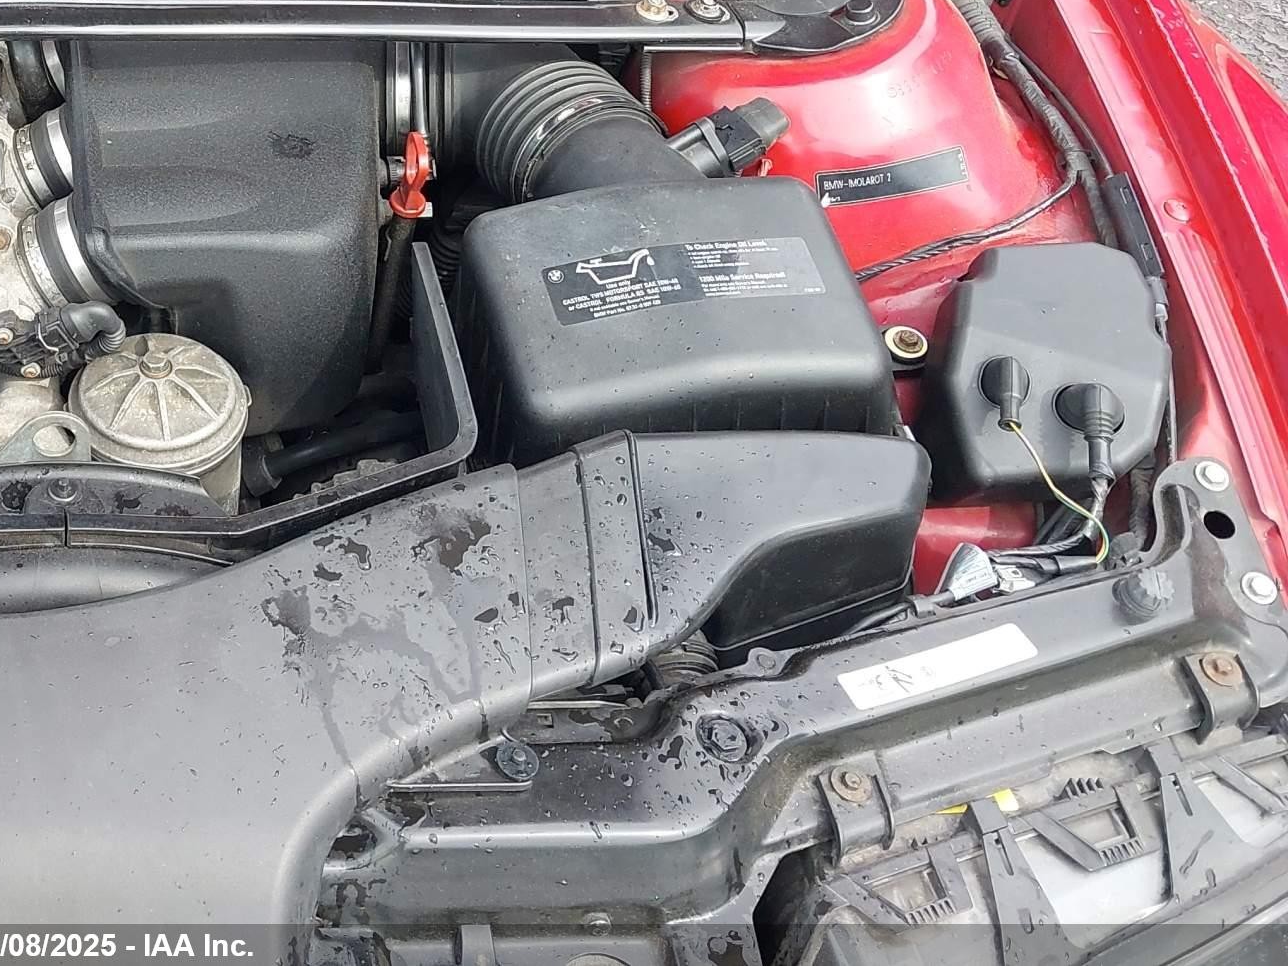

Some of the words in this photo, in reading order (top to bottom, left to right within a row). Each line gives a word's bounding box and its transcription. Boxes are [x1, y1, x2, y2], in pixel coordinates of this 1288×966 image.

[823, 174, 884, 191] BMW-IMOLAROT
[562, 295, 591, 306] CASTROL
[575, 298, 603, 310] CASTROL
